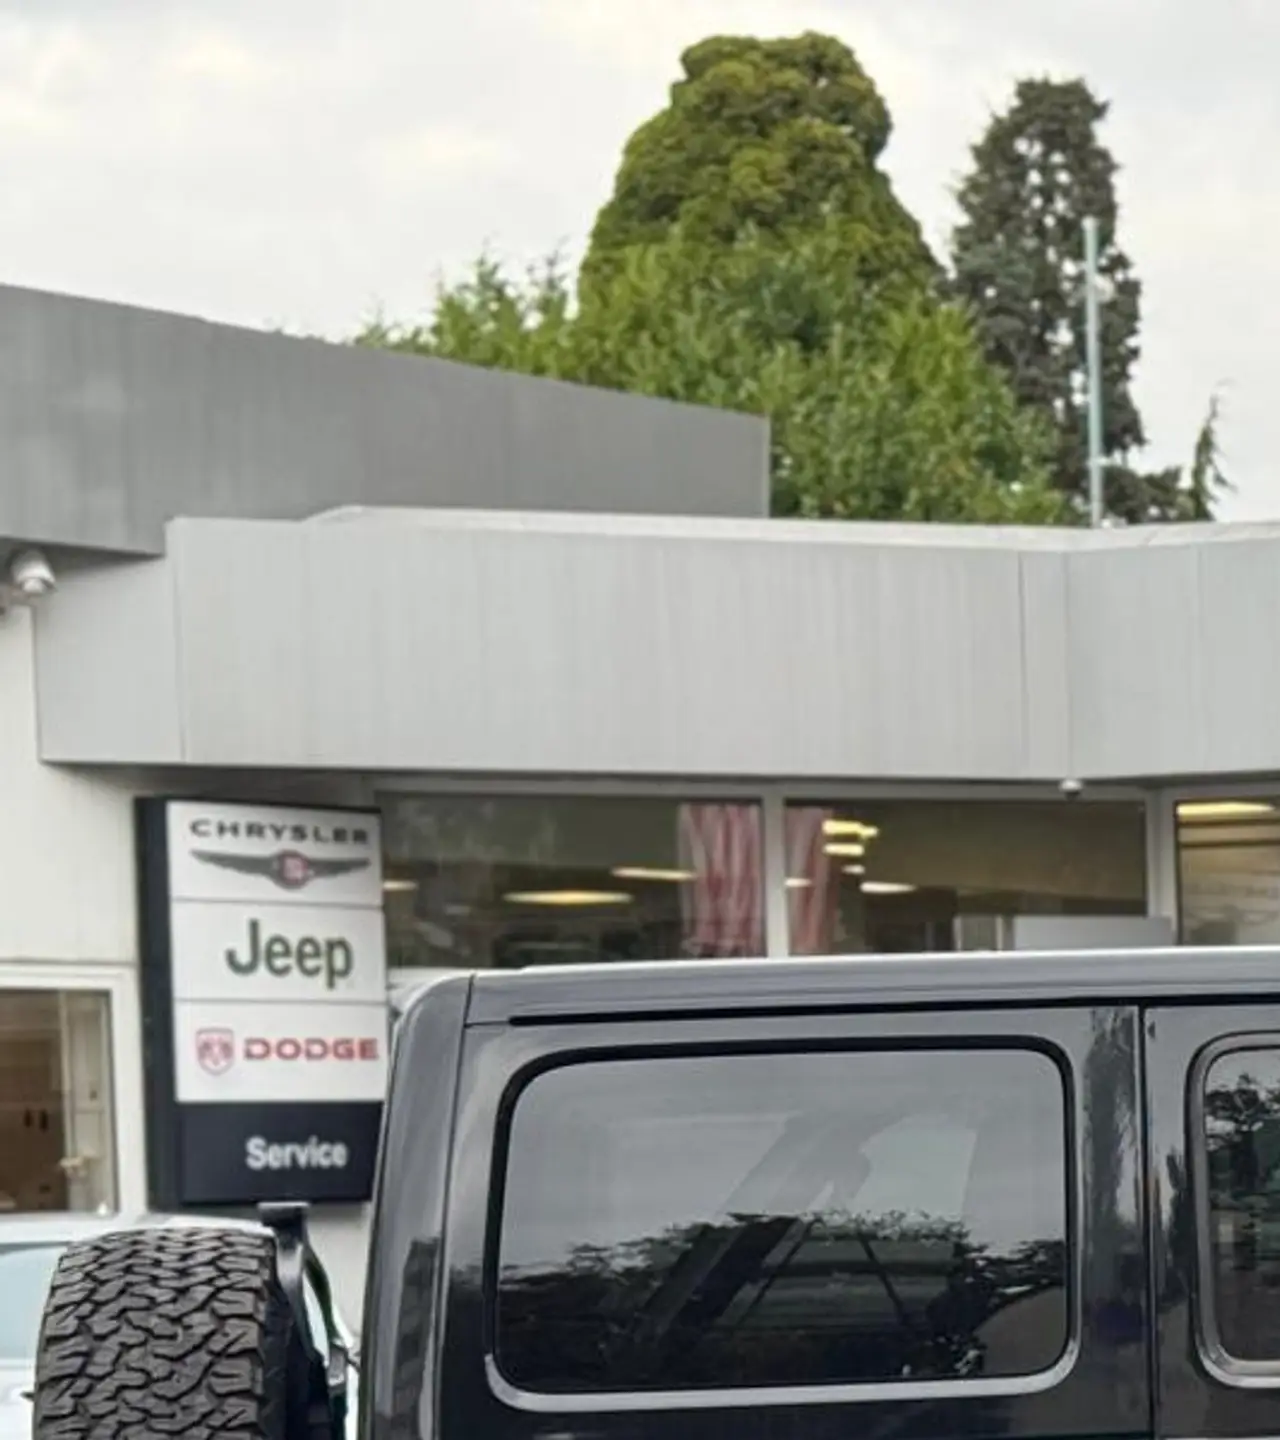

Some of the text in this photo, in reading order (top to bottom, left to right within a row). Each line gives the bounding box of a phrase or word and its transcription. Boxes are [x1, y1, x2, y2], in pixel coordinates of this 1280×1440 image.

[189, 818, 369, 845] CHRYSLER
[225, 917, 354, 991] Jeep
[244, 1036, 379, 1062] DODGE
[245, 1133, 348, 1170] Service
